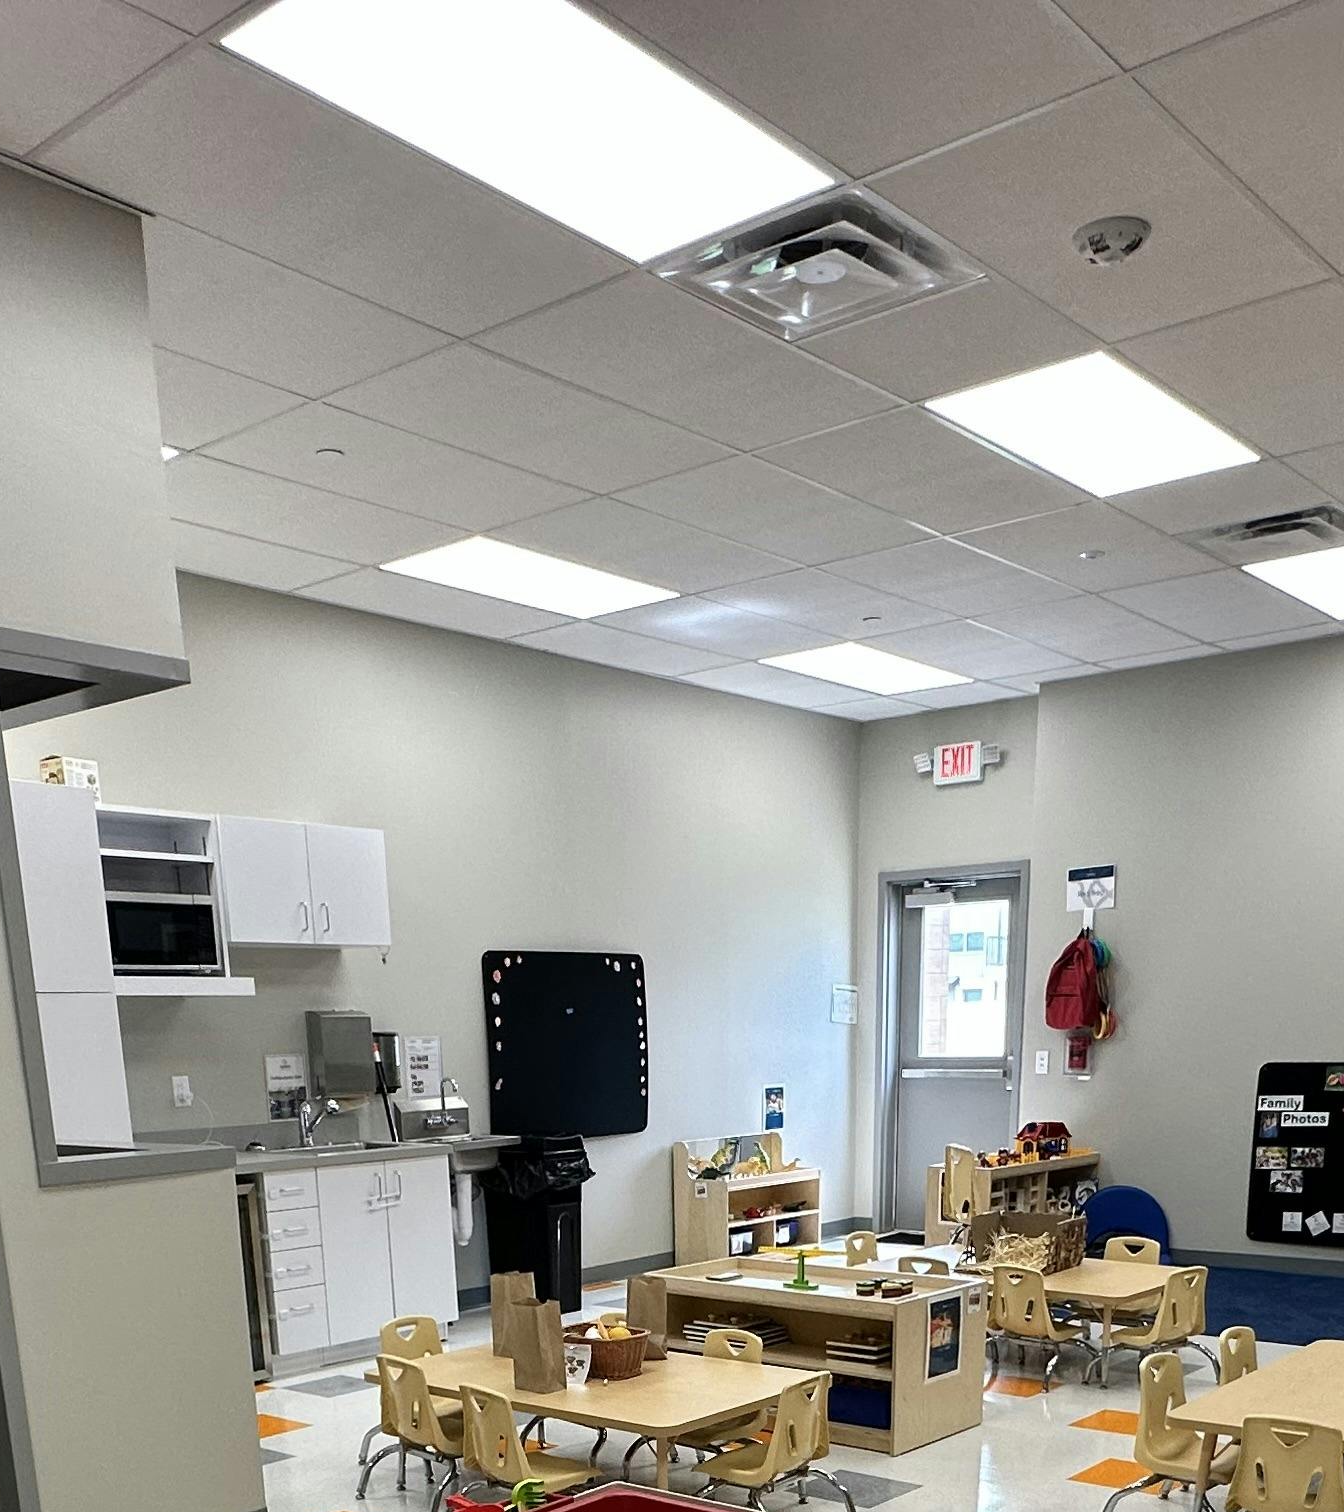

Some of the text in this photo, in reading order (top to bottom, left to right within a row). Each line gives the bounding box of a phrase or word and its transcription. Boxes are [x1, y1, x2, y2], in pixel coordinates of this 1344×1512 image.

[940, 744, 974, 777] EXIT
[1260, 1097, 1301, 1111] Family
[1283, 1113, 1327, 1124] Photos
